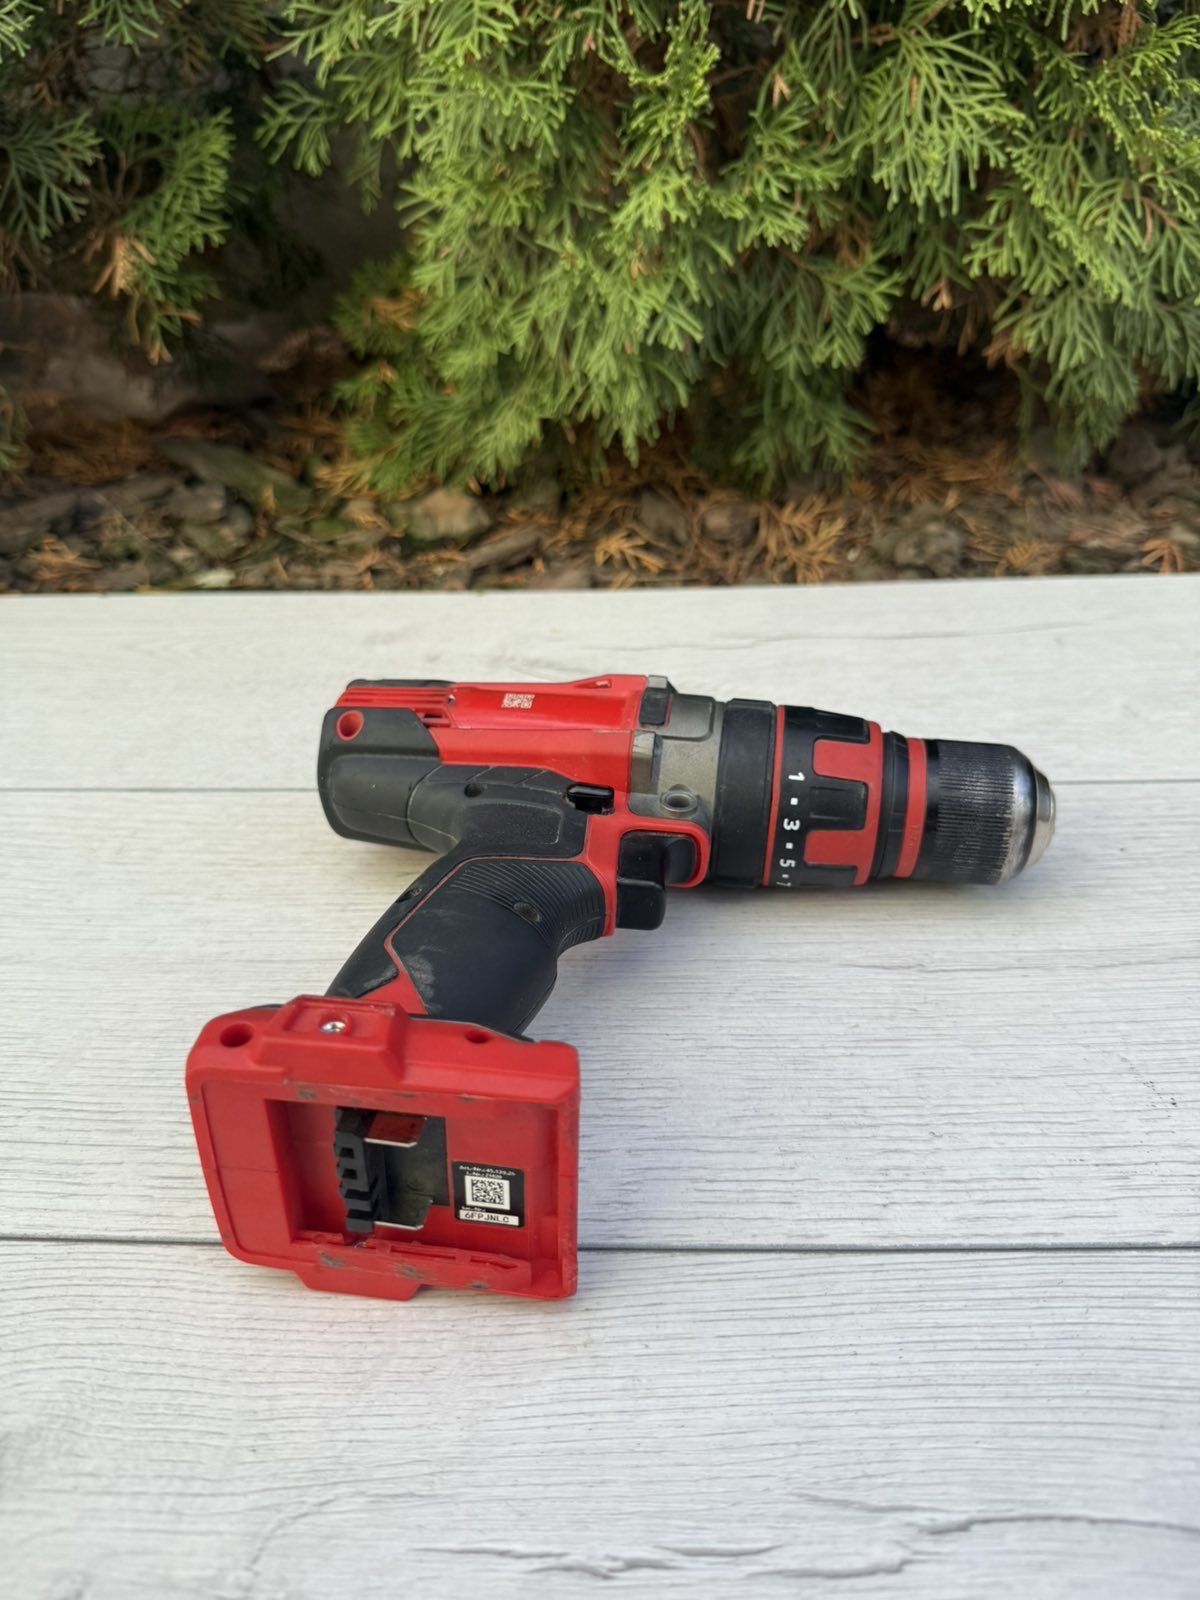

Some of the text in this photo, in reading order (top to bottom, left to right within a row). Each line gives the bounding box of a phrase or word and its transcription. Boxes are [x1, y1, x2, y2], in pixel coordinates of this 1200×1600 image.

[788, 772, 805, 782] 1
[783, 818, 800, 831] 3
[779, 858, 796, 868] 5
